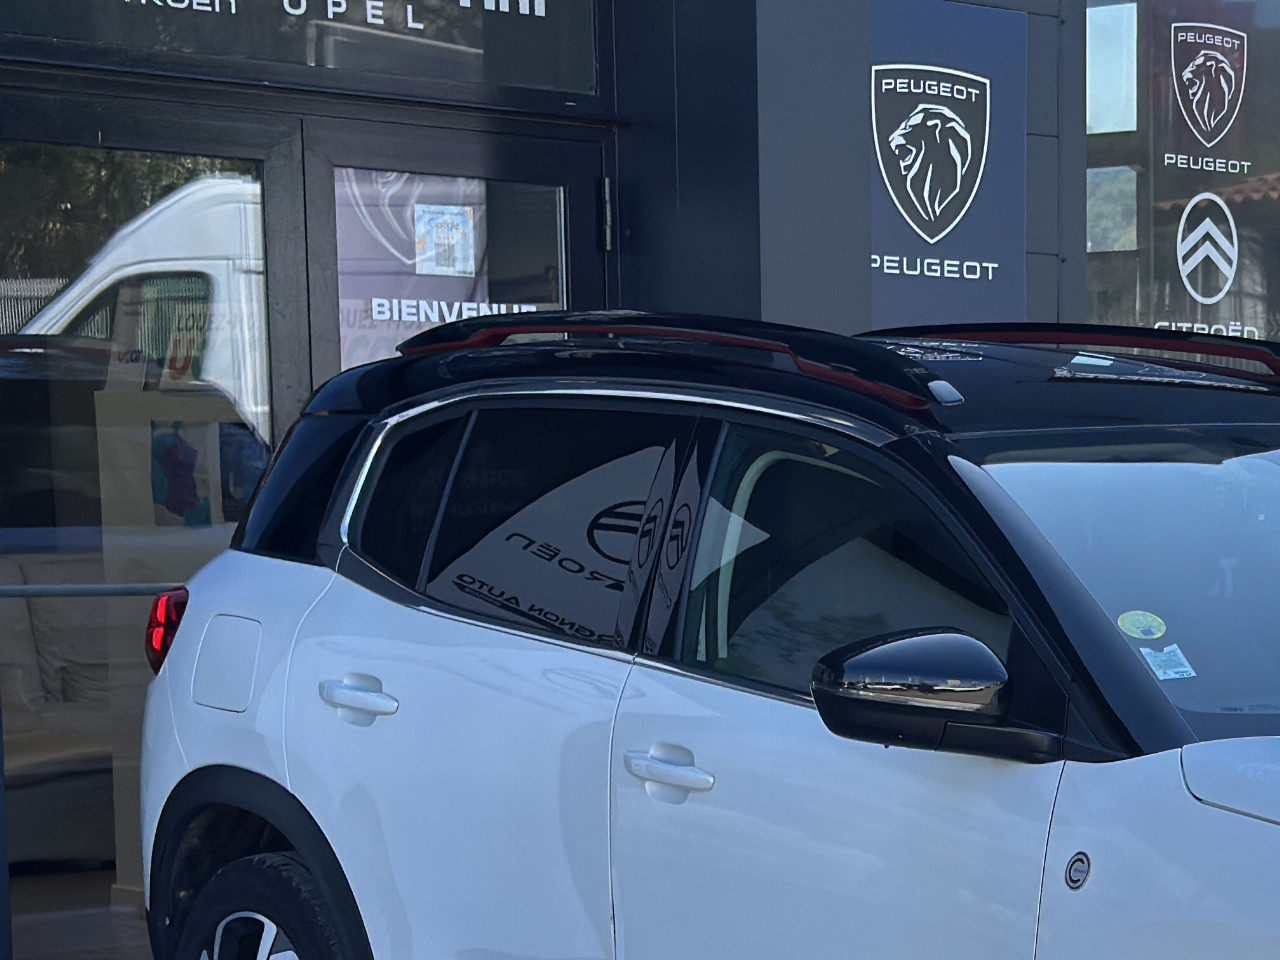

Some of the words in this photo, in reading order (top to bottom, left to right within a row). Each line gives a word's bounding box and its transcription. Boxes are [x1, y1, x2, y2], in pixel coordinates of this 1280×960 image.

[282, 0, 425, 30] OPEL
[1177, 32, 1241, 50] PEUGEOT
[881, 79, 980, 102] PEUGEOT
[1164, 153, 1252, 174] PEUGEOT
[870, 254, 999, 281] PEUGEOT
